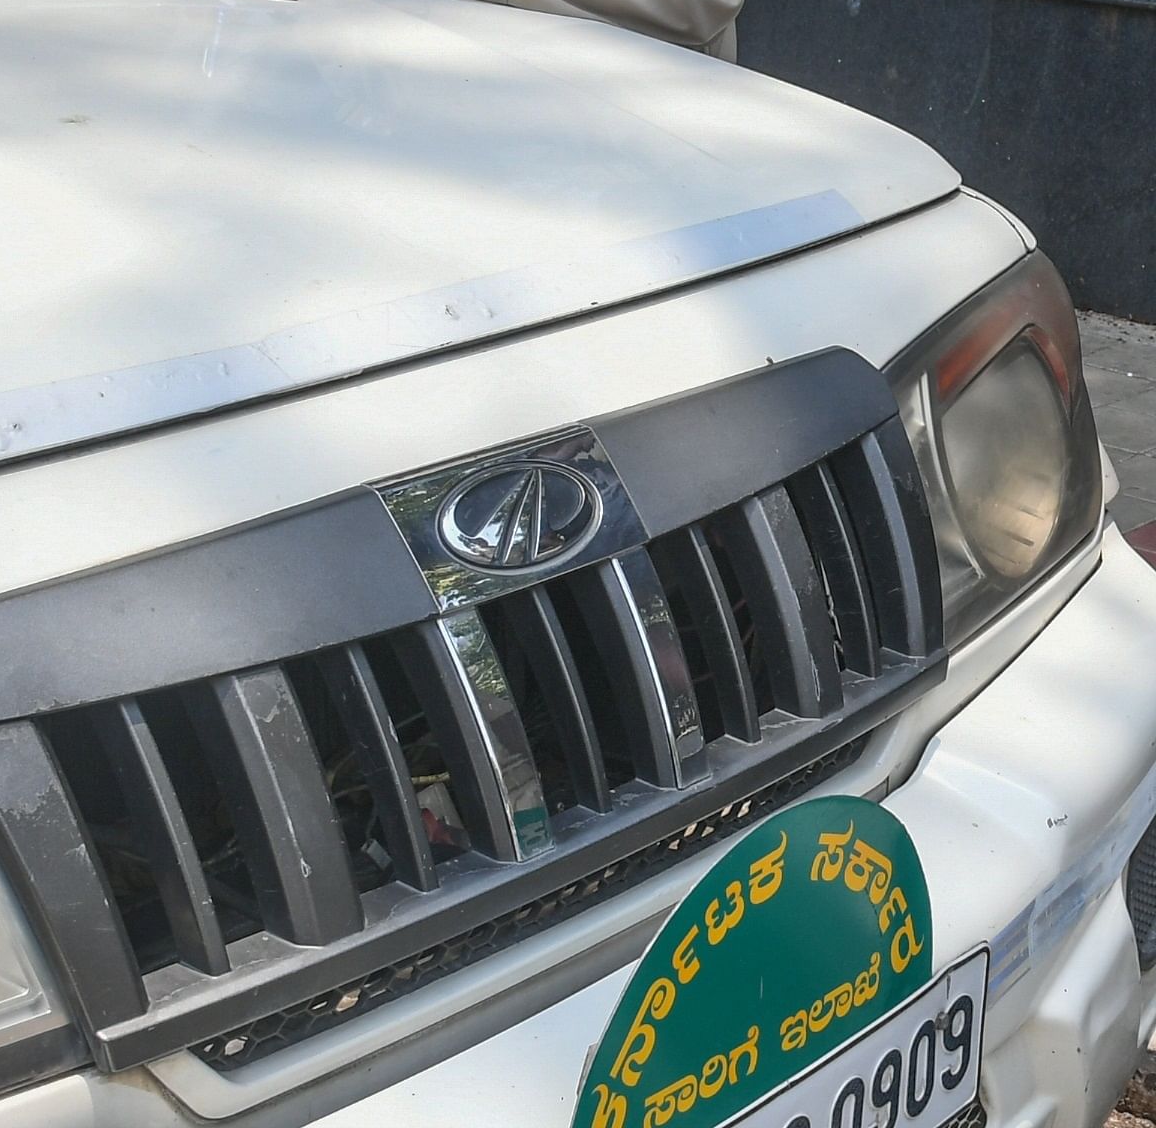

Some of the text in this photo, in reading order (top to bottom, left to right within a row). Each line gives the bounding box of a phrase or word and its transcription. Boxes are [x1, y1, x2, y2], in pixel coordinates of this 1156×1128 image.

[810, 819, 924, 974] ಸರ್ಕಾರ
[643, 952, 881, 1128] ಸಾರಿಗೆ ಇಲಾಖೆ
